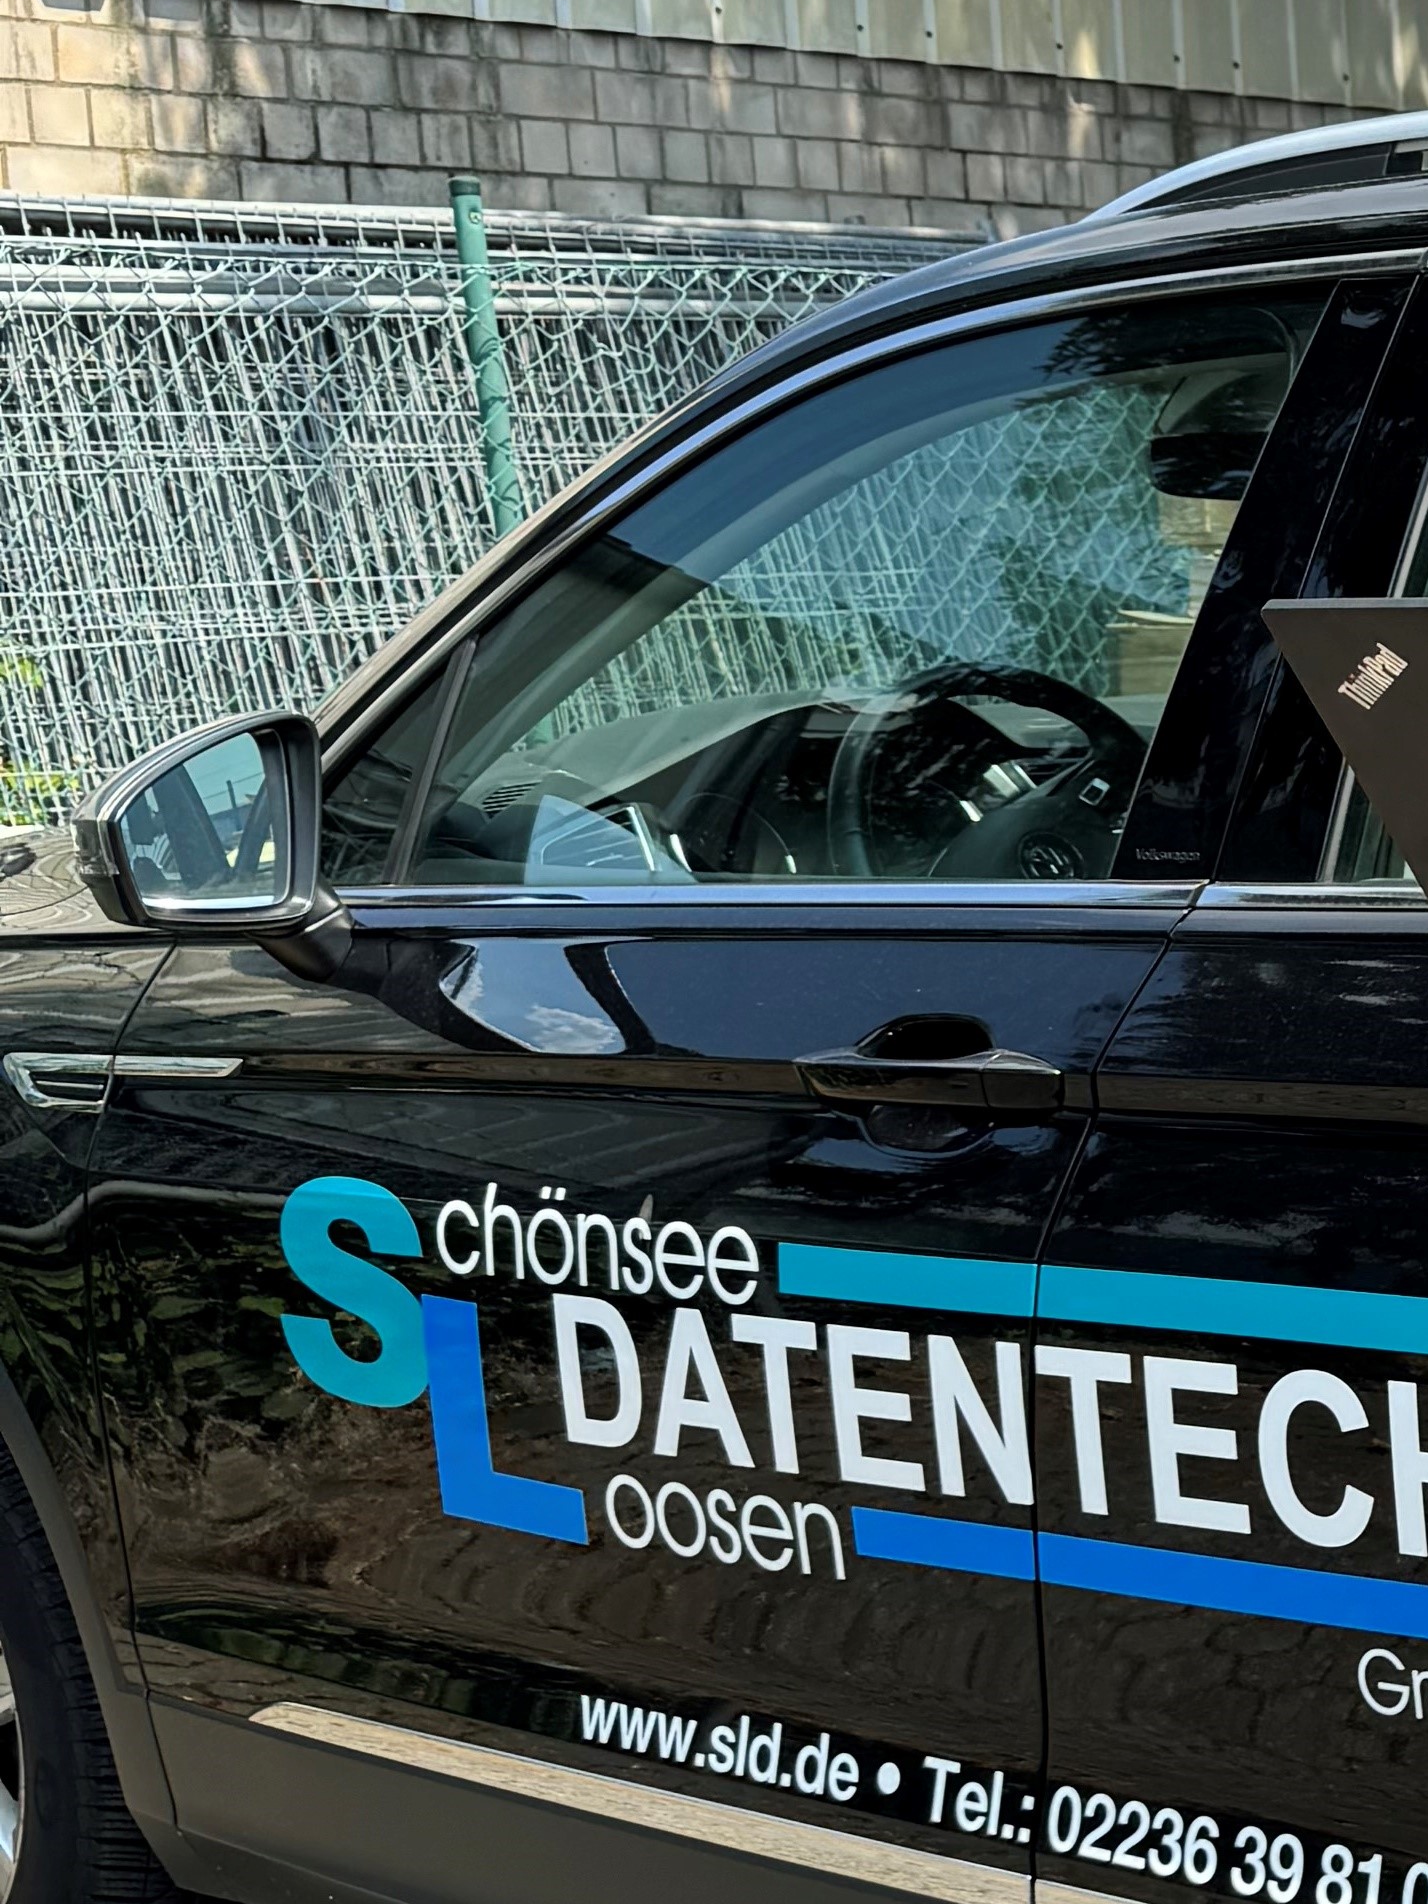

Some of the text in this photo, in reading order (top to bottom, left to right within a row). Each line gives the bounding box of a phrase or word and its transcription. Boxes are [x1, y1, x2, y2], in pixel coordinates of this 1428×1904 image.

[1337, 642, 1409, 711] ThinkPad
[580, 1694, 860, 1801] www.sld.de
[922, 1755, 1036, 1844] Tel.:
[1047, 1785, 1220, 1885] 02236
[1230, 1825, 1304, 1904] 39
